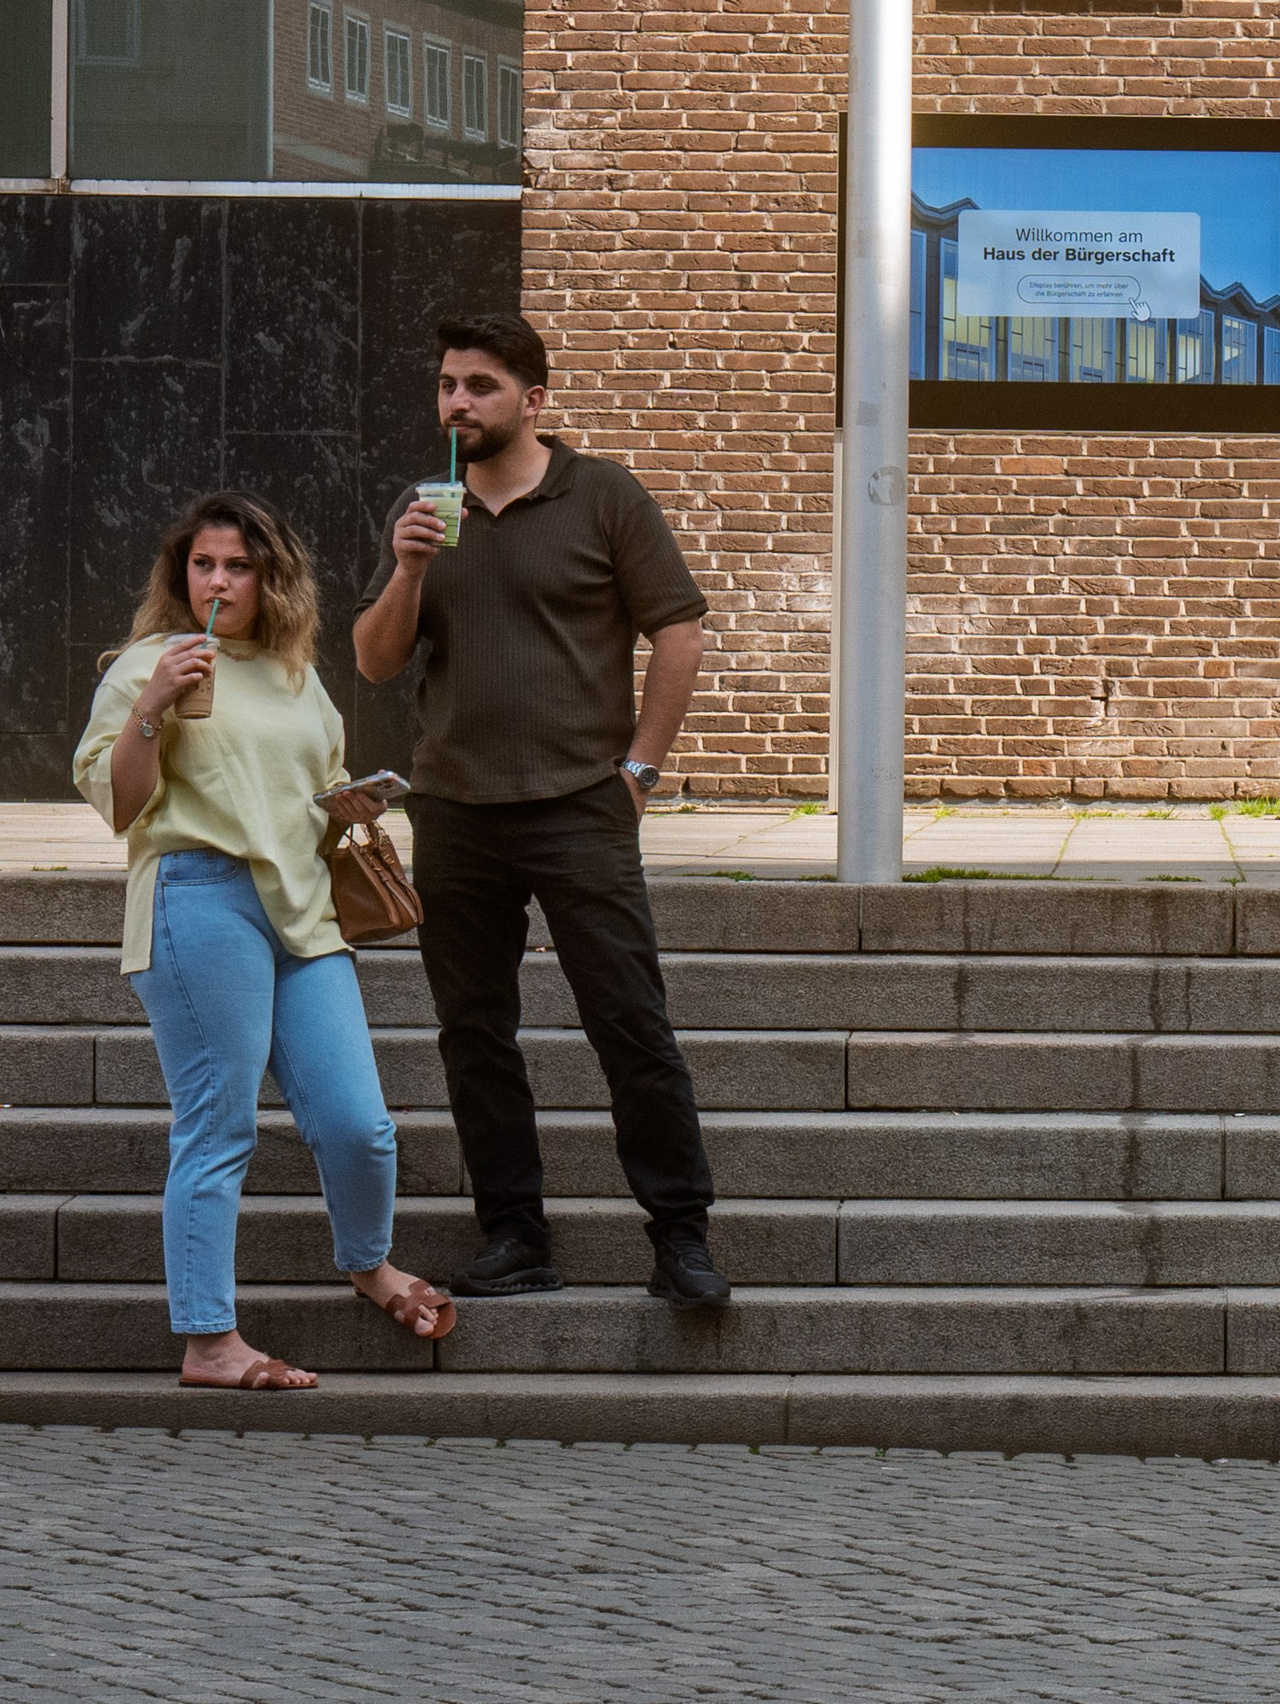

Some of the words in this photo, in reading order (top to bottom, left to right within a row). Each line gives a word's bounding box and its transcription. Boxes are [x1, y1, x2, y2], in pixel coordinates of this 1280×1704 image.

[1016, 228, 1112, 242] Willkommen
[1119, 232, 1142, 242] am
[984, 247, 1025, 260] Haus
[1032, 248, 1059, 260] der
[1066, 247, 1175, 265] Bürgerschaft
